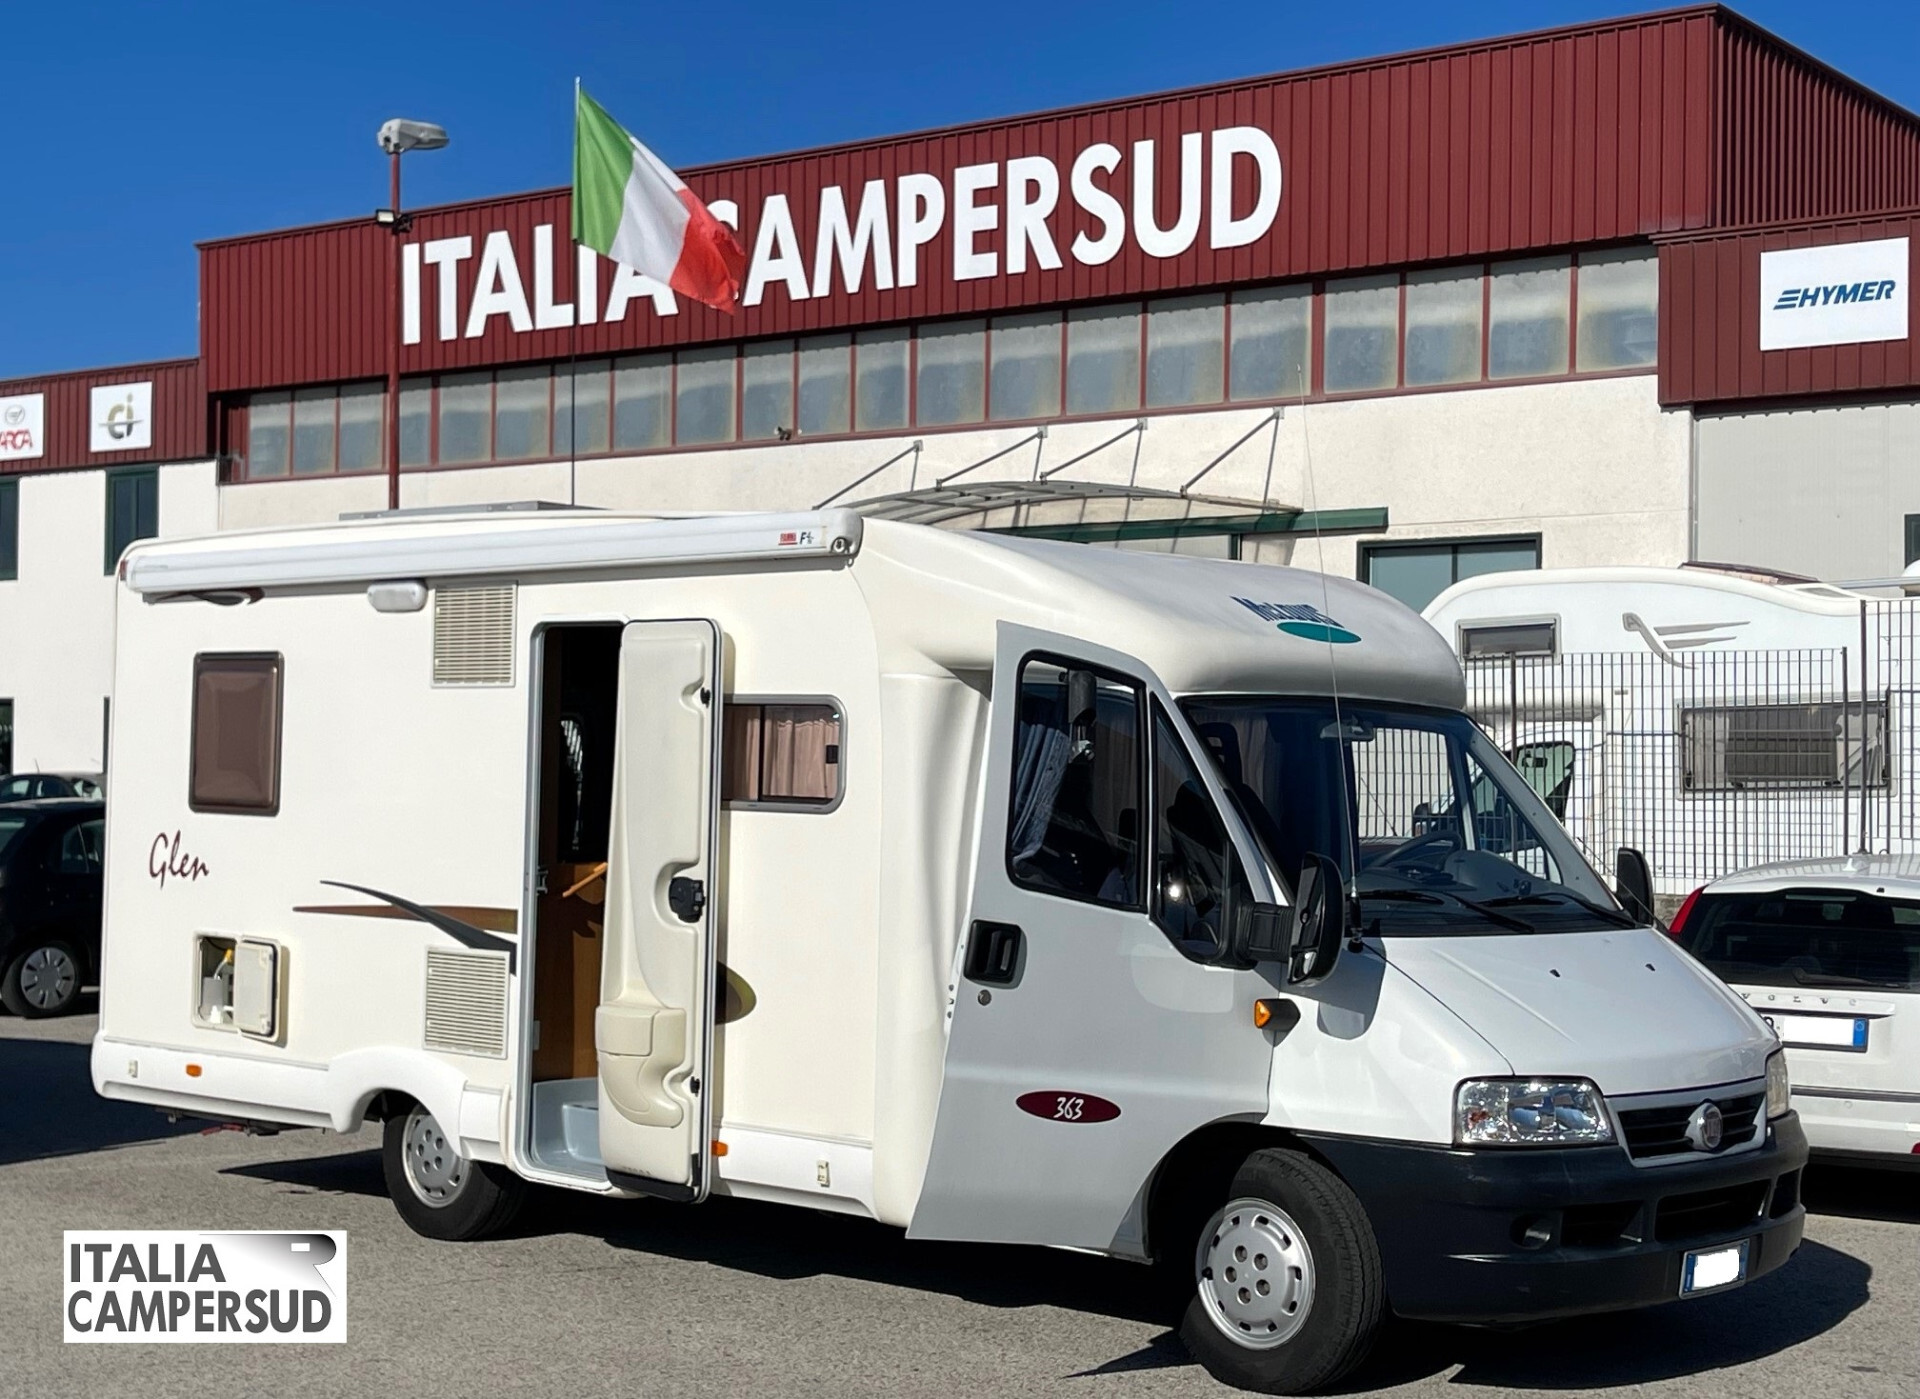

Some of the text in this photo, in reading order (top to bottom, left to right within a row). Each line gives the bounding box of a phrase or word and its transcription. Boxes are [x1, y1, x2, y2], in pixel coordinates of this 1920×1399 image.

[402, 224, 679, 346] ITALIA
[1798, 279, 1897, 309] HYMER
[149, 829, 210, 890] Glen
[1053, 1097, 1085, 1121] 363
